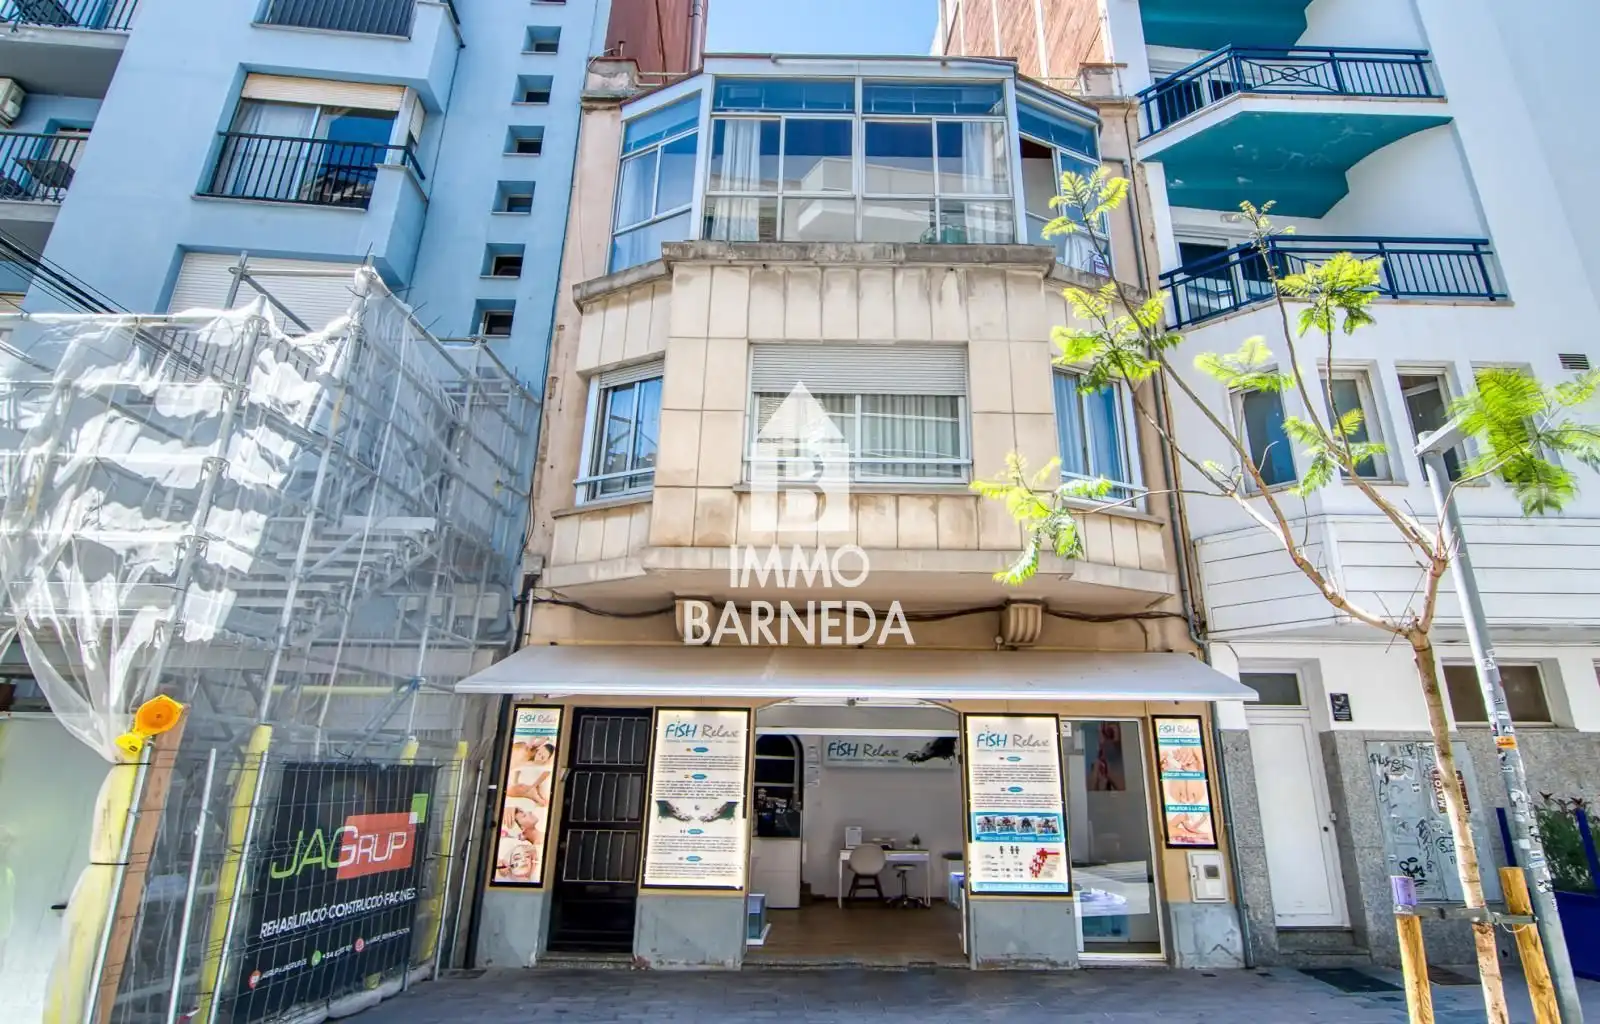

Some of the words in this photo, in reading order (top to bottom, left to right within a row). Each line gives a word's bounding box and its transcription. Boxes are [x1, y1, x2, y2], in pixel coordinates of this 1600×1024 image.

[701, 724, 740, 738] Relax
[1012, 734, 1049, 748] Relax
[863, 743, 899, 757] Relax
